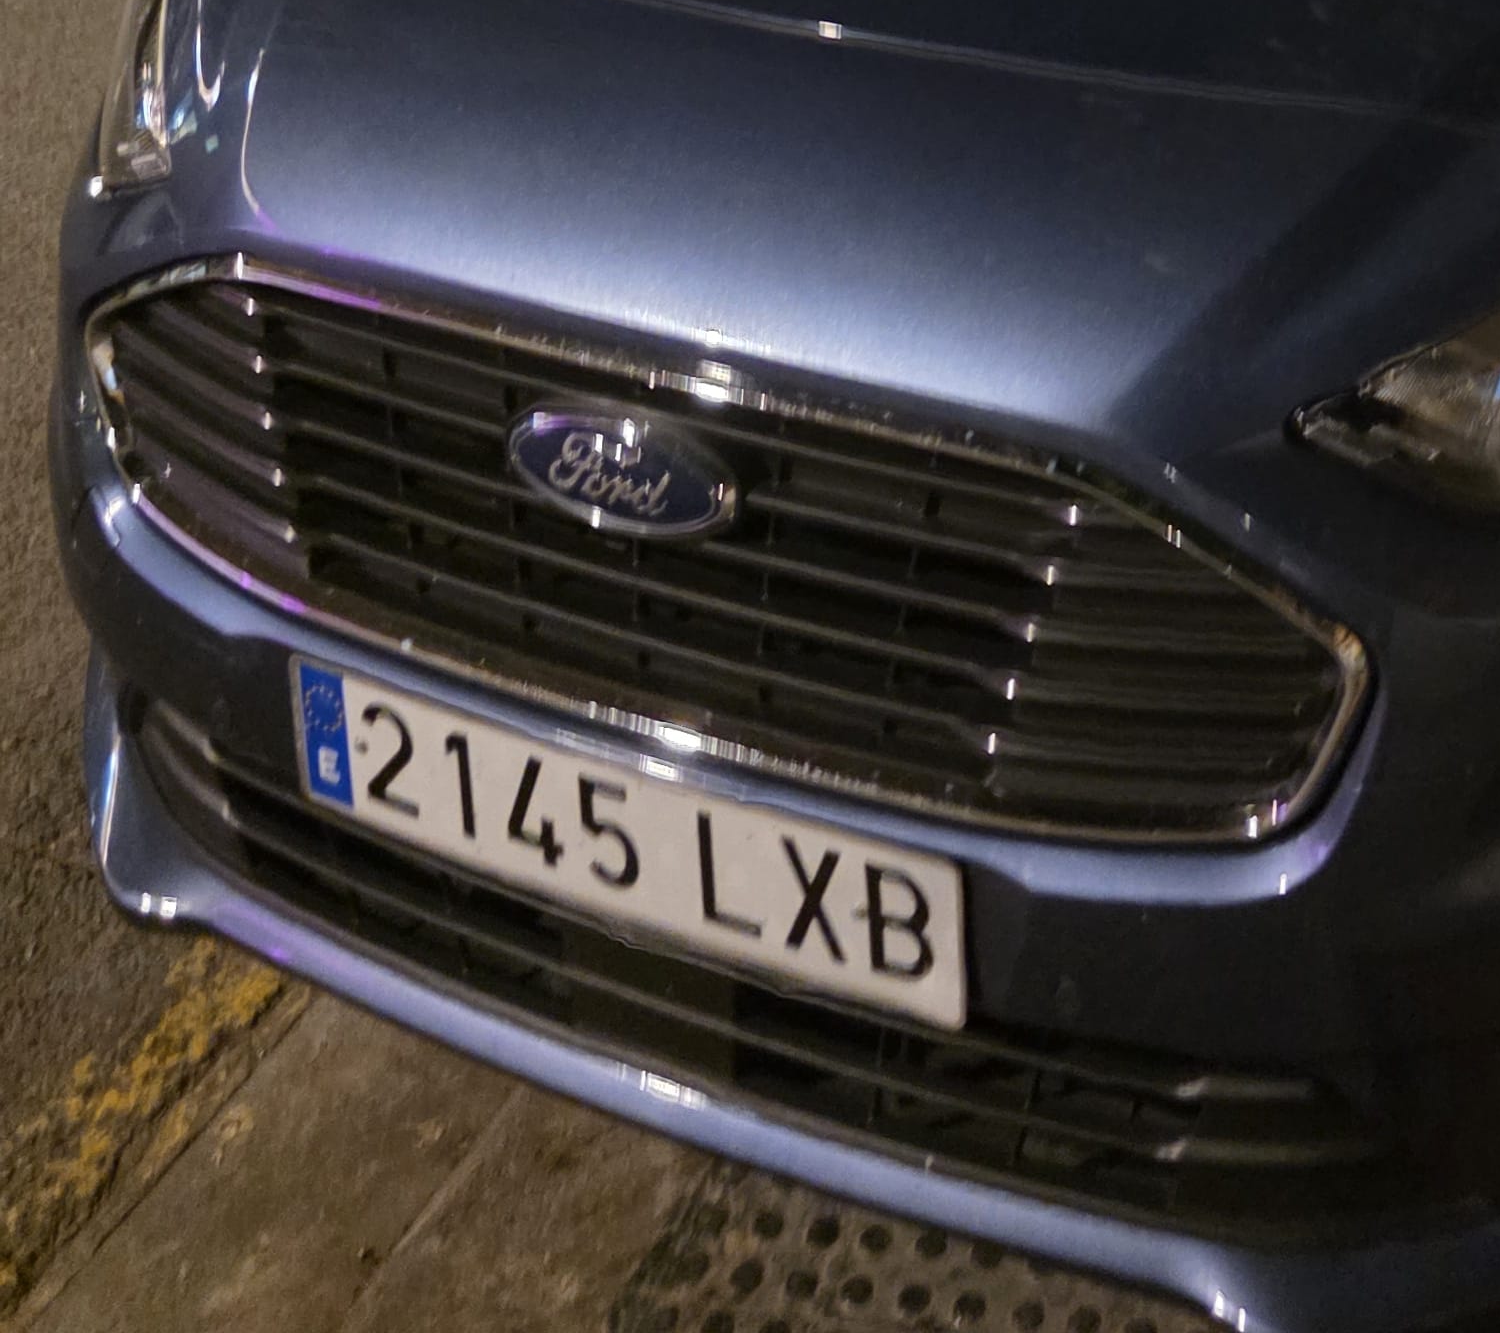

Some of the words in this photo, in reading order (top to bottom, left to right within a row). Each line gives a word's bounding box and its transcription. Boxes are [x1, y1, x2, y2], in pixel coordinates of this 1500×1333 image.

[548, 432, 672, 517] Ford
[361, 703, 641, 888] 2145
[696, 810, 935, 978] LXB
